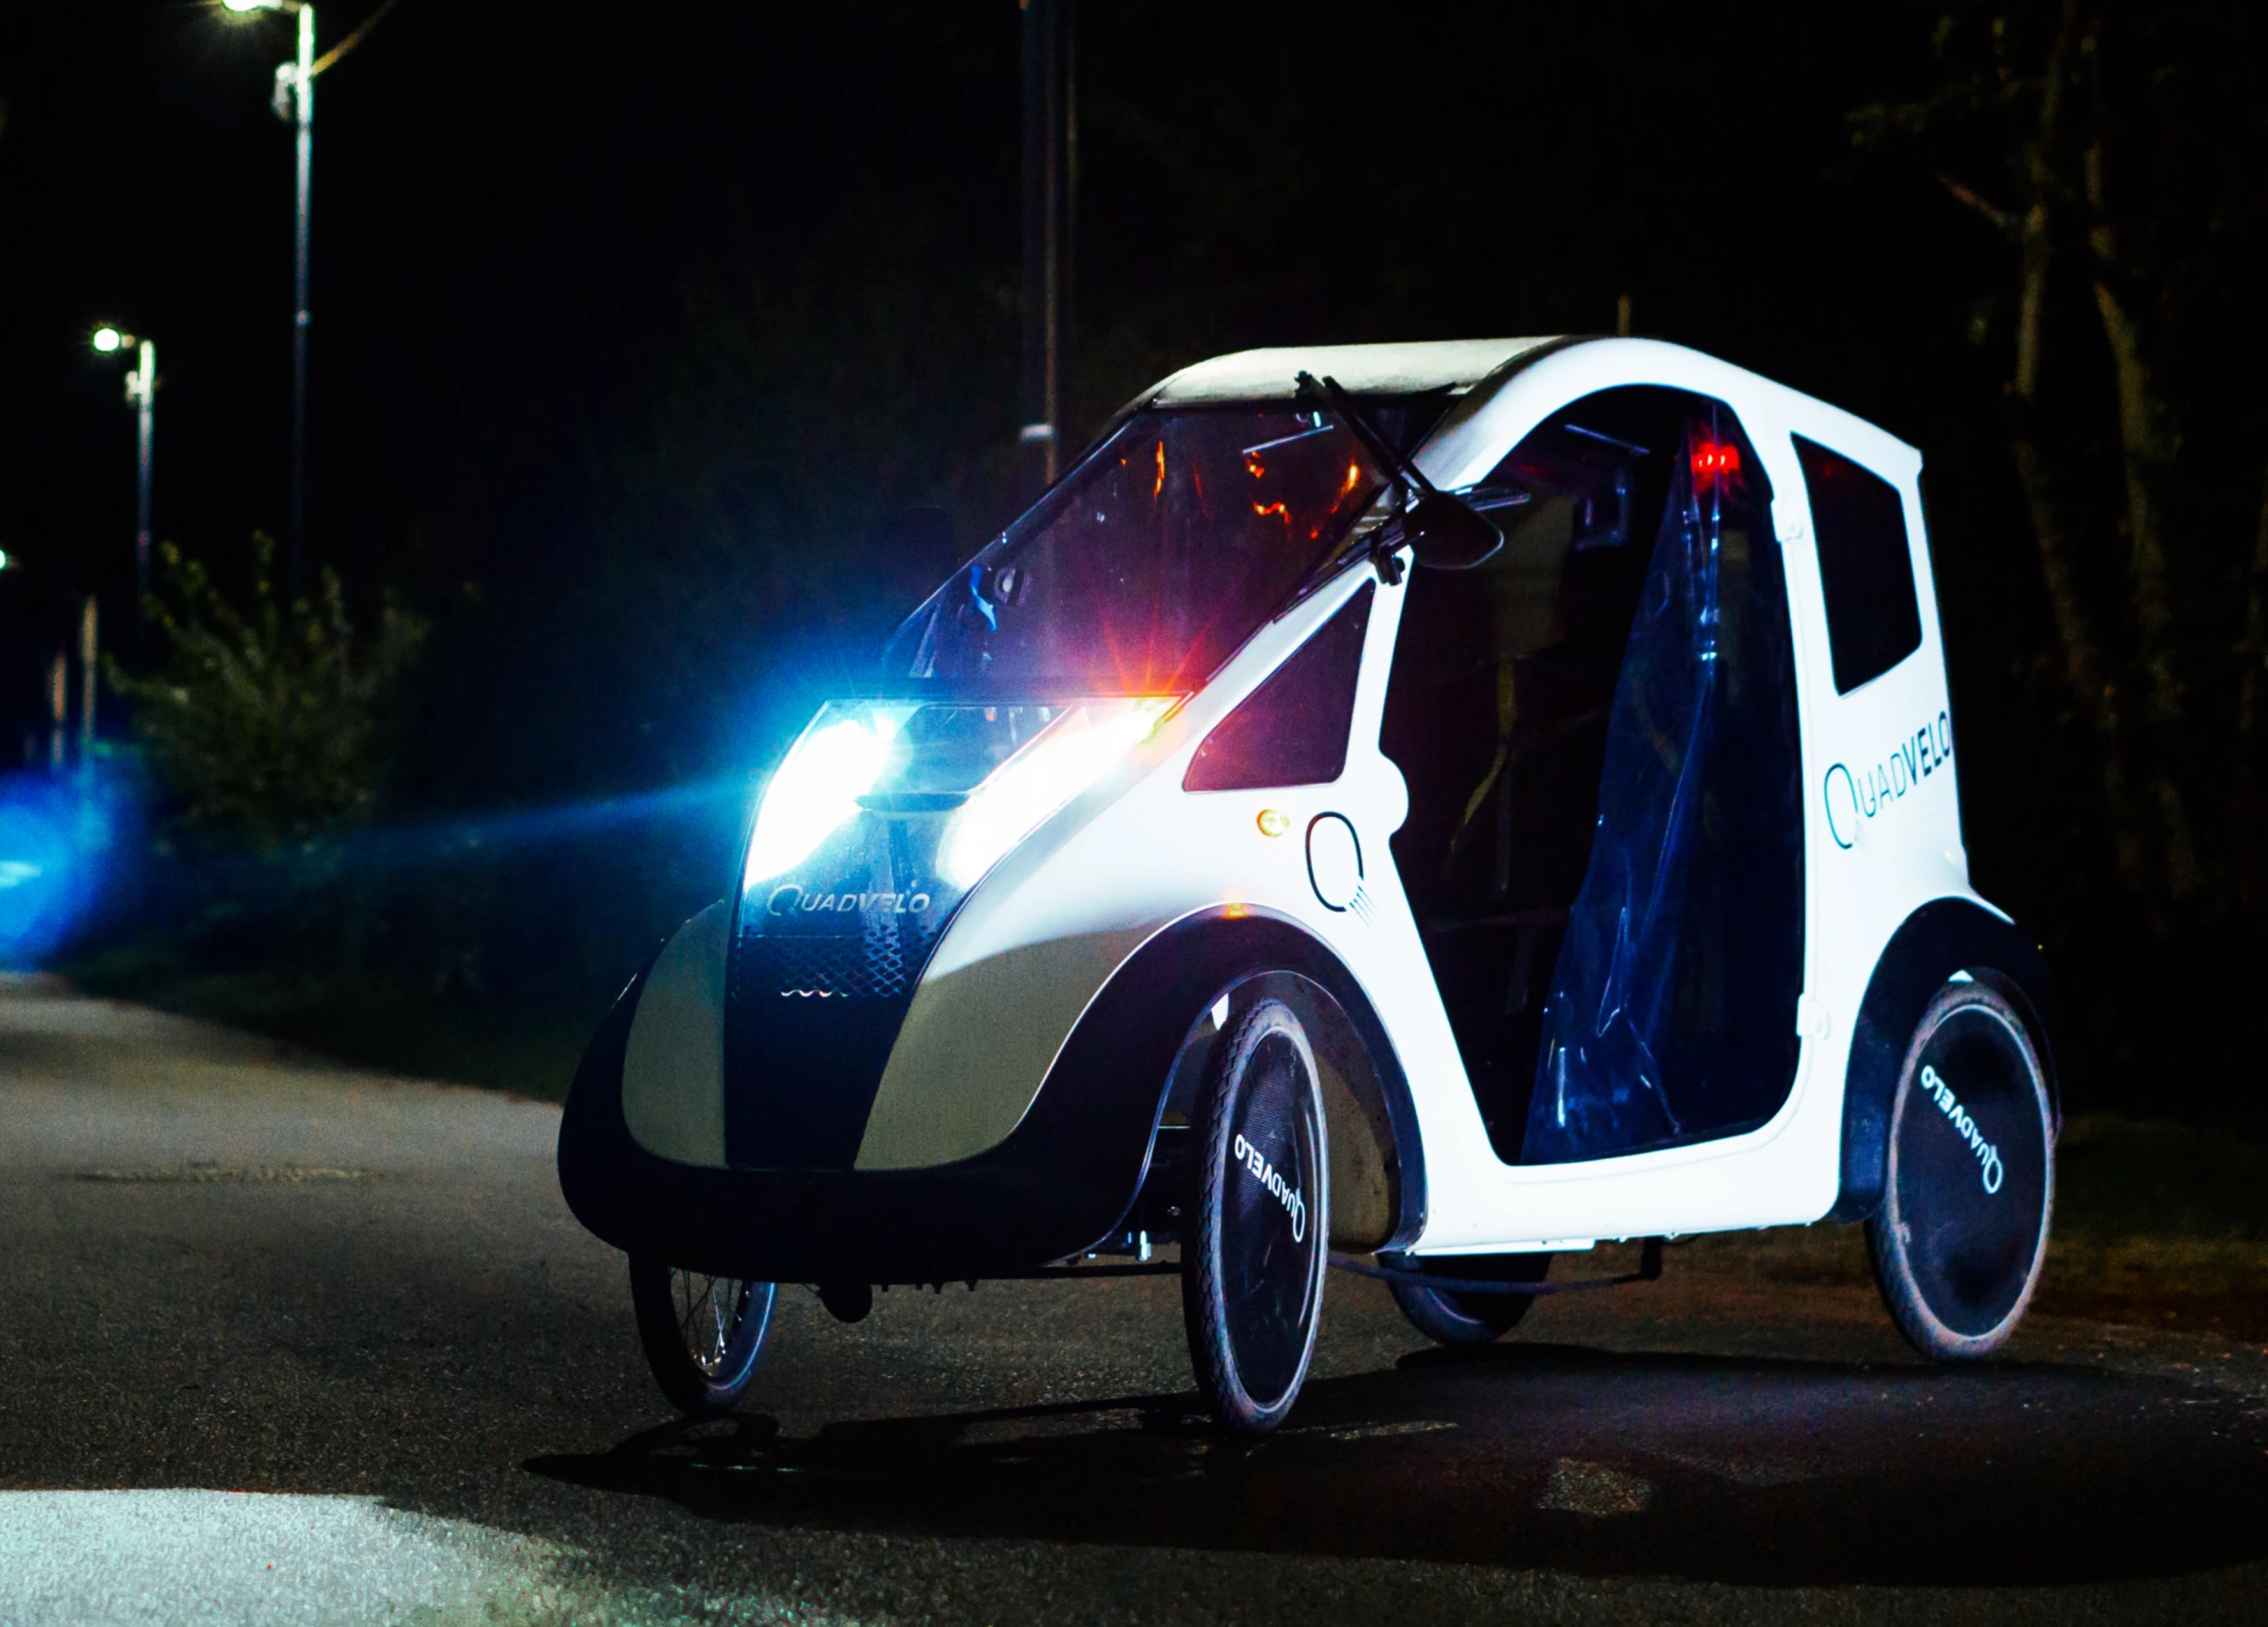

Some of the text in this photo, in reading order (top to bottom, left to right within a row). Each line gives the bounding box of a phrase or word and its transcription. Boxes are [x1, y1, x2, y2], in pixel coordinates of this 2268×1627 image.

[1823, 710, 1950, 850] QUADVELO
[766, 884, 930, 916] QUADVELO
[1234, 1133, 1306, 1243] QUADVELO
[1921, 1064, 2003, 1195] QUADVELO
